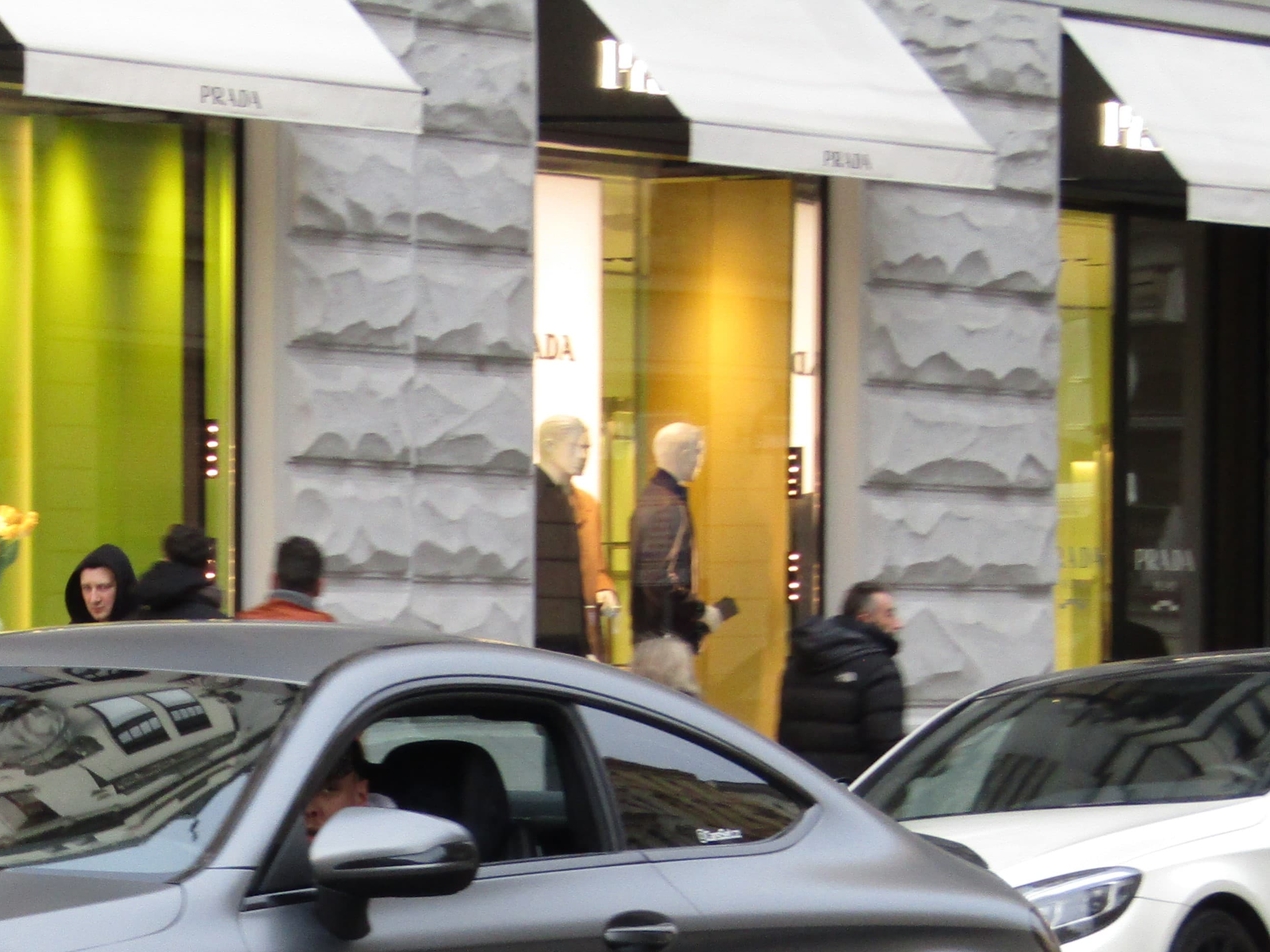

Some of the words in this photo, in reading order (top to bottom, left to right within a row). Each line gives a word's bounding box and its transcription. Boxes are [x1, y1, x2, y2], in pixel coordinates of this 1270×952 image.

[199, 85, 262, 109] PRADA
[822, 150, 873, 170] PRADA
[1133, 548, 1197, 571] PRADA
